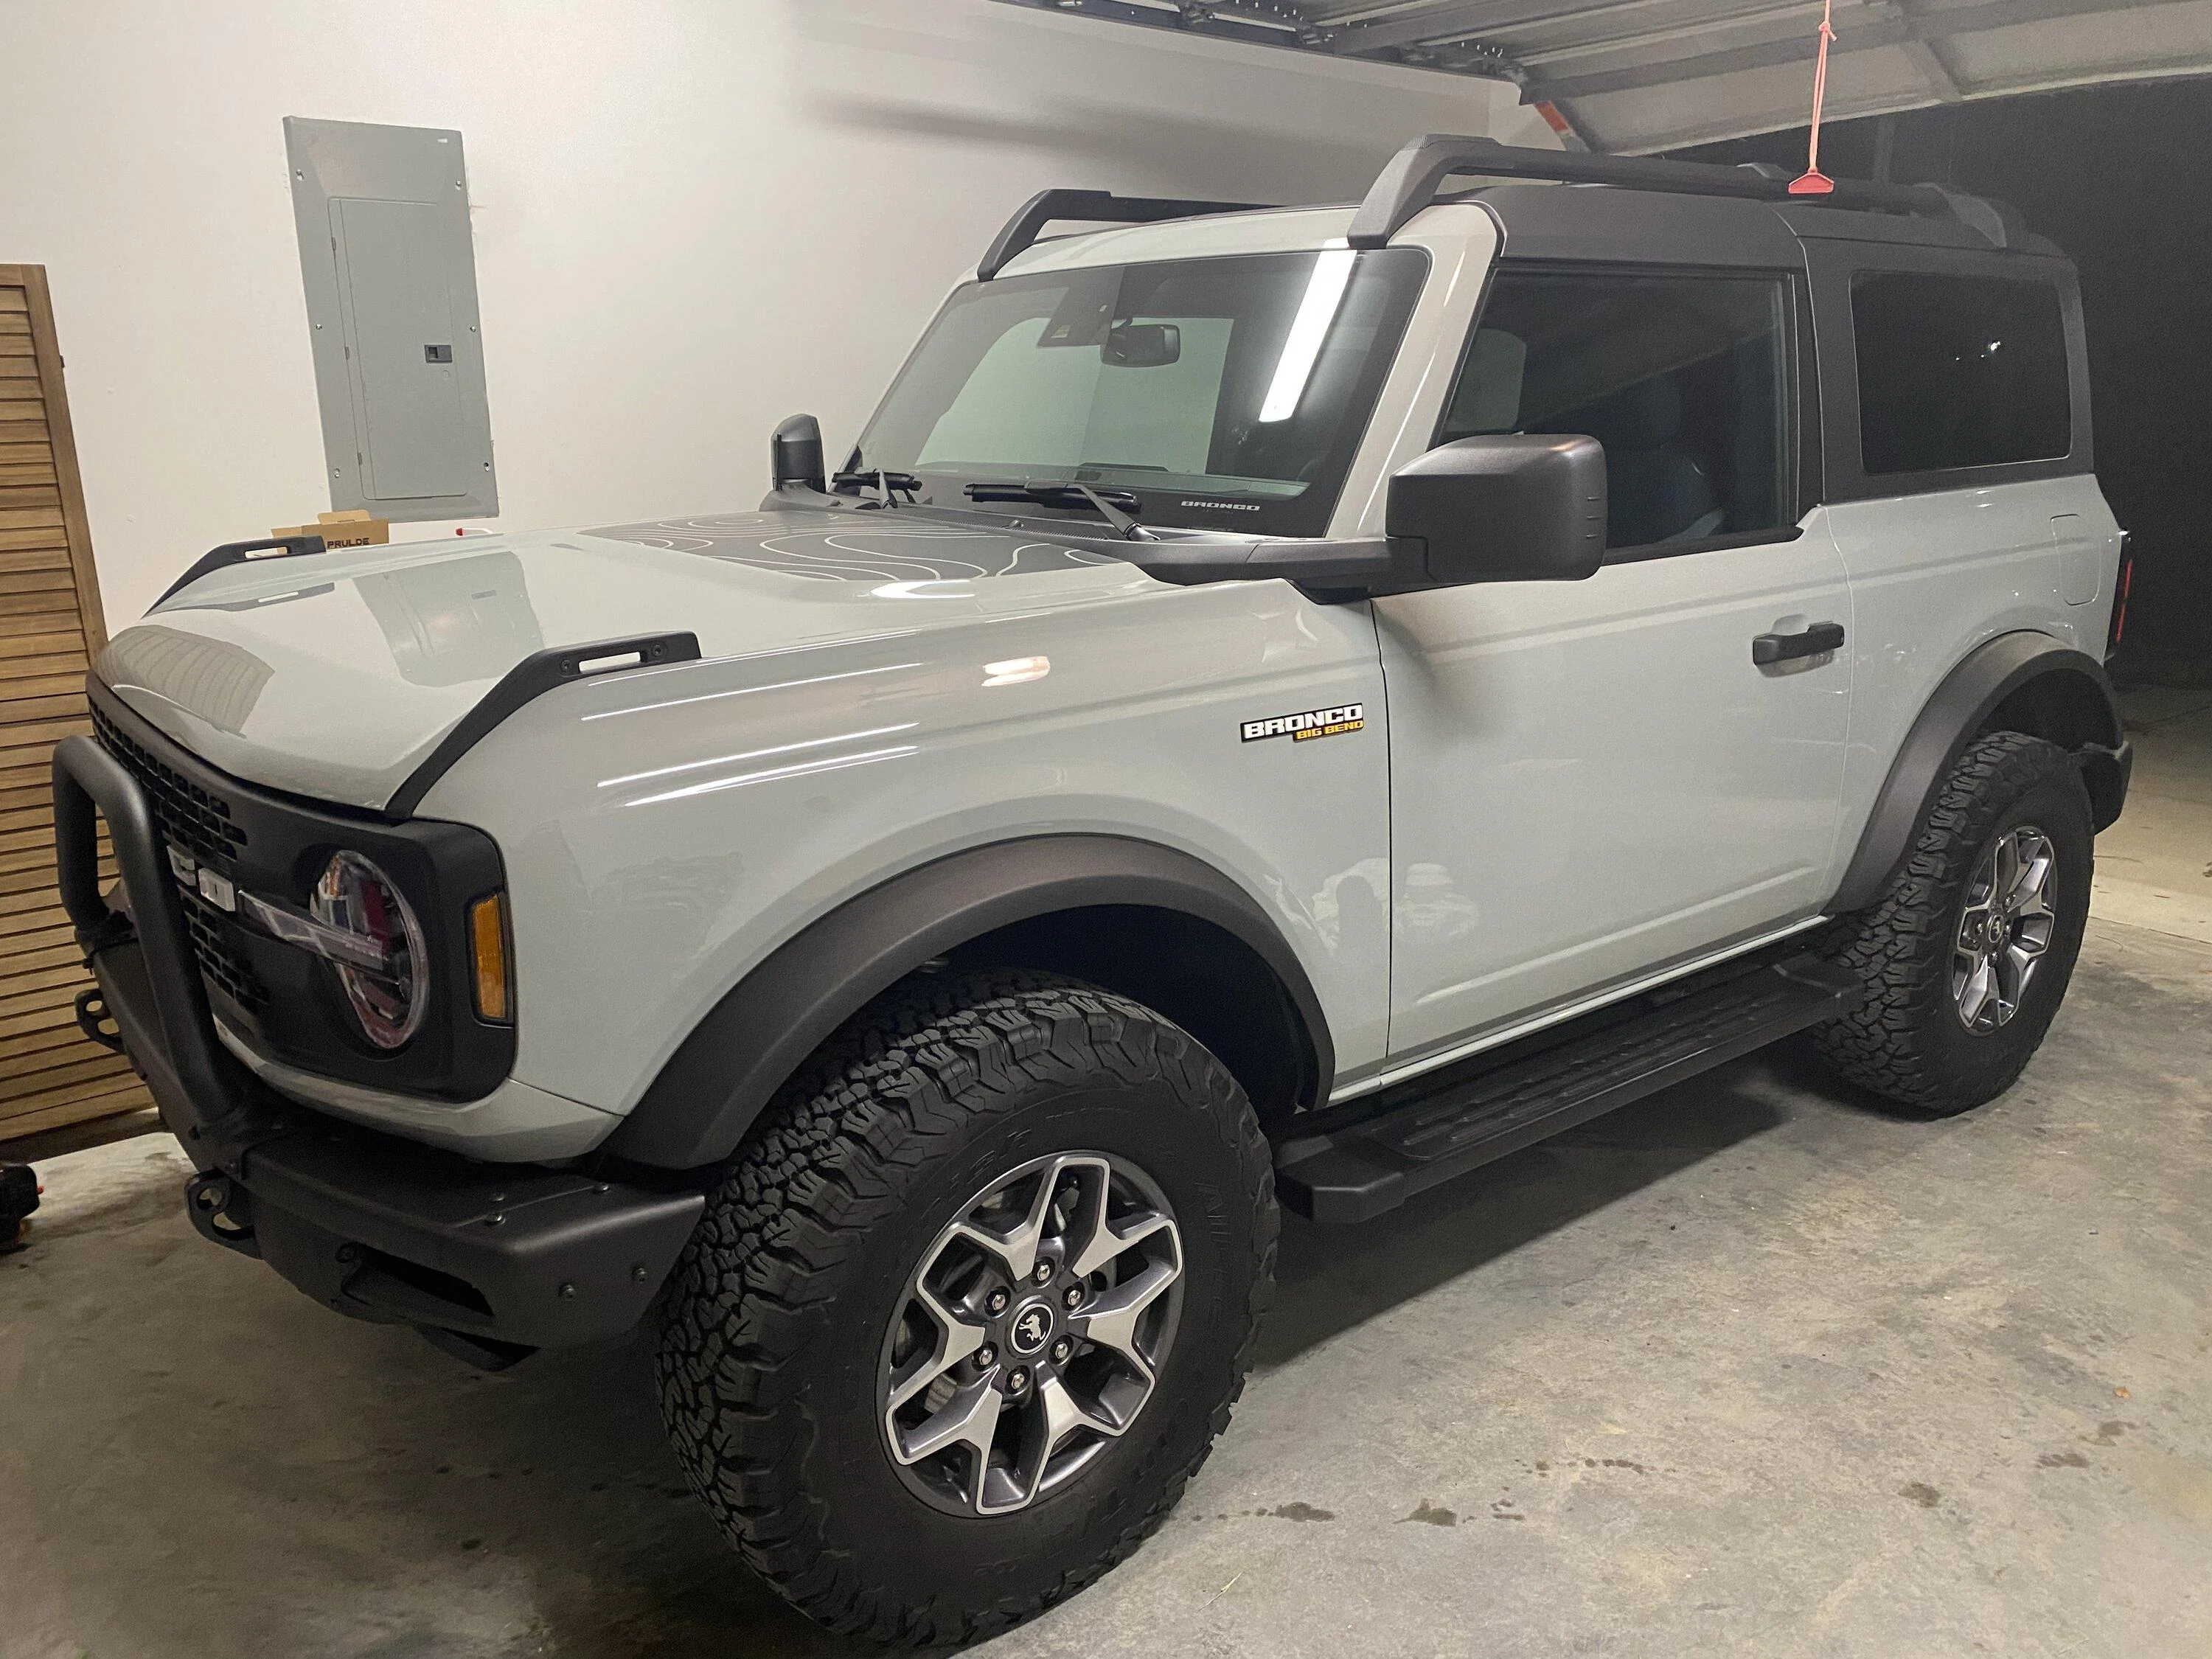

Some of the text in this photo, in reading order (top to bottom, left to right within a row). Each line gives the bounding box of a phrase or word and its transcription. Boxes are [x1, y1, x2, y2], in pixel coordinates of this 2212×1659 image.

[1181, 501, 1260, 511] BRONCO
[327, 538, 369, 549] PRULDE
[1244, 704, 1363, 739] BRONCO
[1295, 720, 1364, 740] BIG BEND
